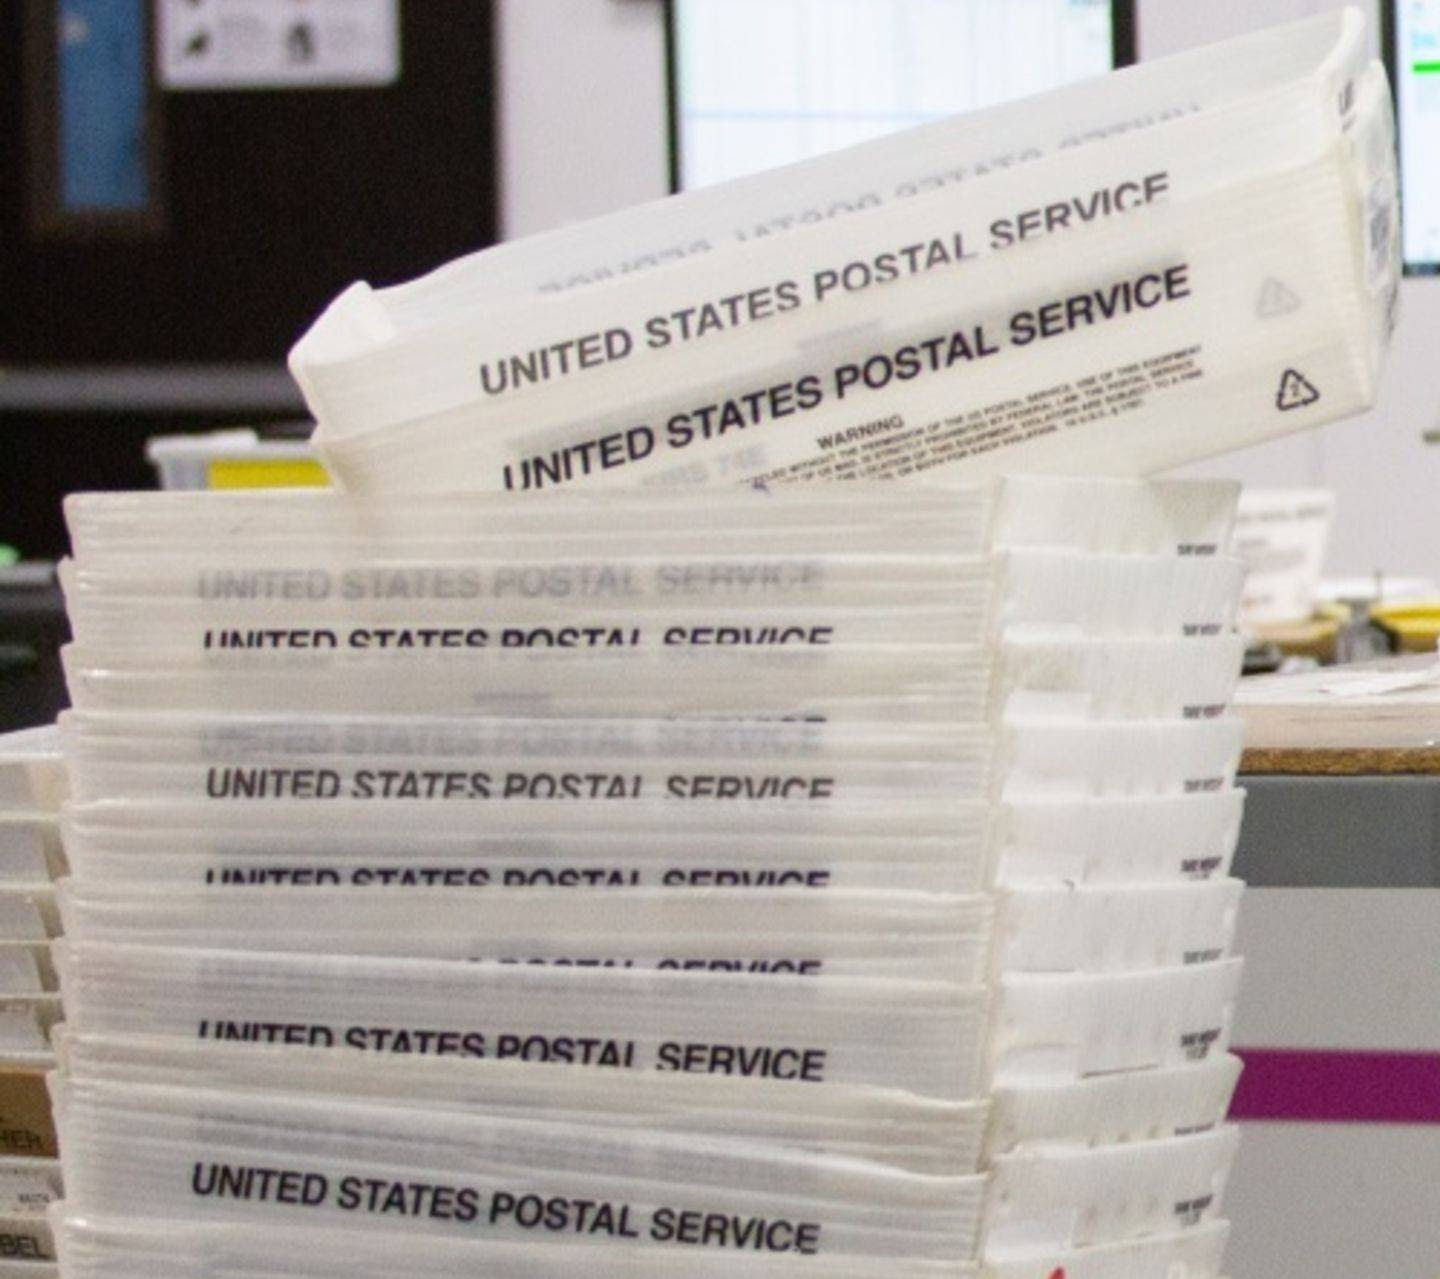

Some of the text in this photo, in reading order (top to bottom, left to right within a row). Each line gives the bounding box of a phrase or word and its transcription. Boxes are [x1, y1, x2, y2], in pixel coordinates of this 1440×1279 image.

[480, 170, 1172, 396] UNITED STATES POSTAL SERVICE
[503, 426, 655, 491] UNITED
[666, 376, 823, 447] STATES
[834, 327, 1000, 400] POSTAL
[1007, 262, 1192, 350] SERVICE
[816, 414, 905, 451] WARNING
[206, 768, 836, 799] UNITED STATES POSTAL SERVICE
[199, 1020, 828, 1083] UNITED STATES POSTAL SERVICE
[191, 1162, 821, 1255] UNITED STATES POSTAL SERVICE
